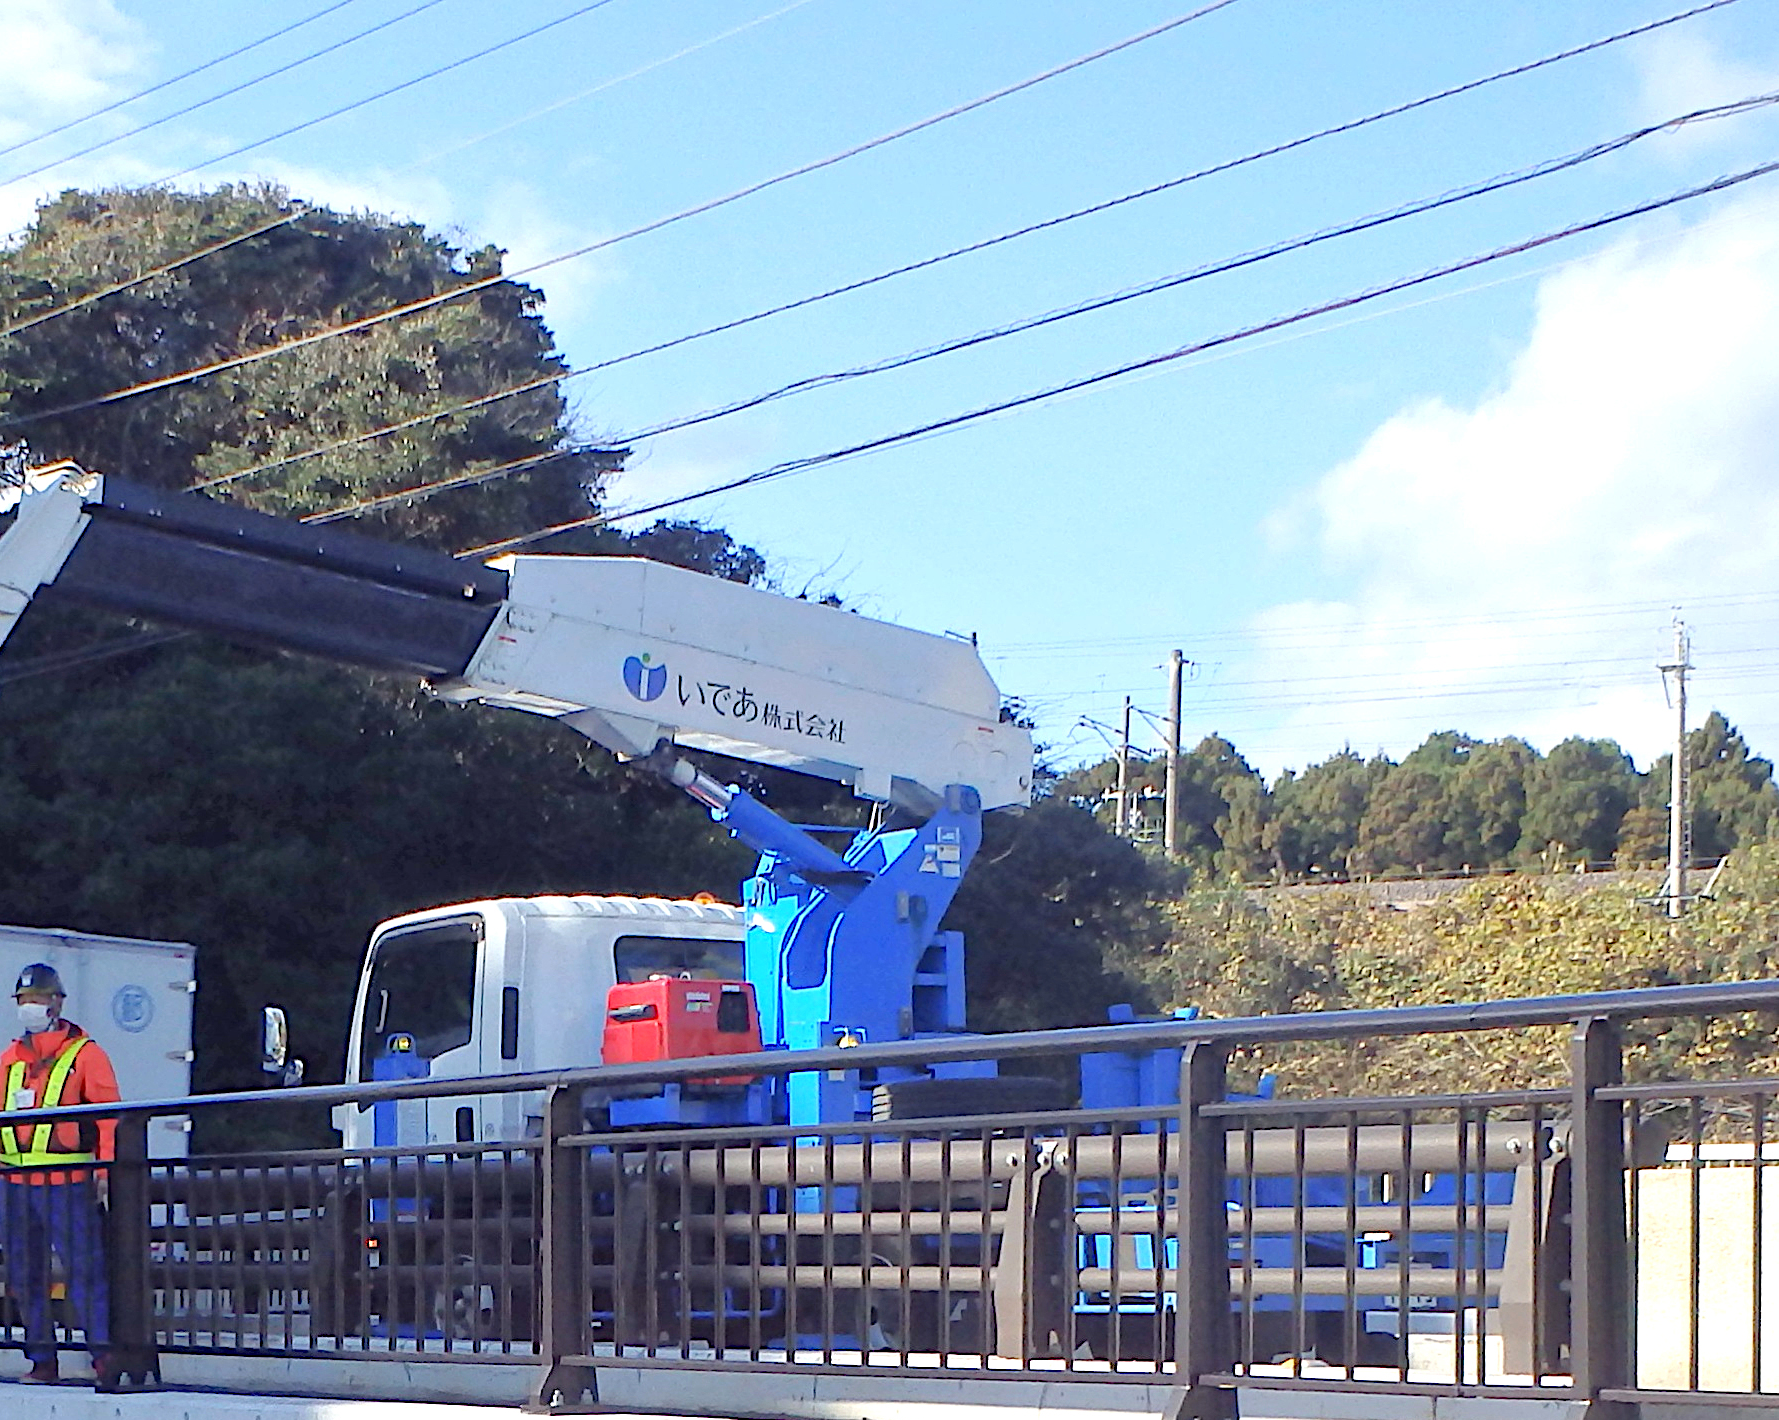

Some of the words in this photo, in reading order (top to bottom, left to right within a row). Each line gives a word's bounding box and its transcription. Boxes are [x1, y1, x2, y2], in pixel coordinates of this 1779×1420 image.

[677, 674, 846, 745] いであ株式会社
